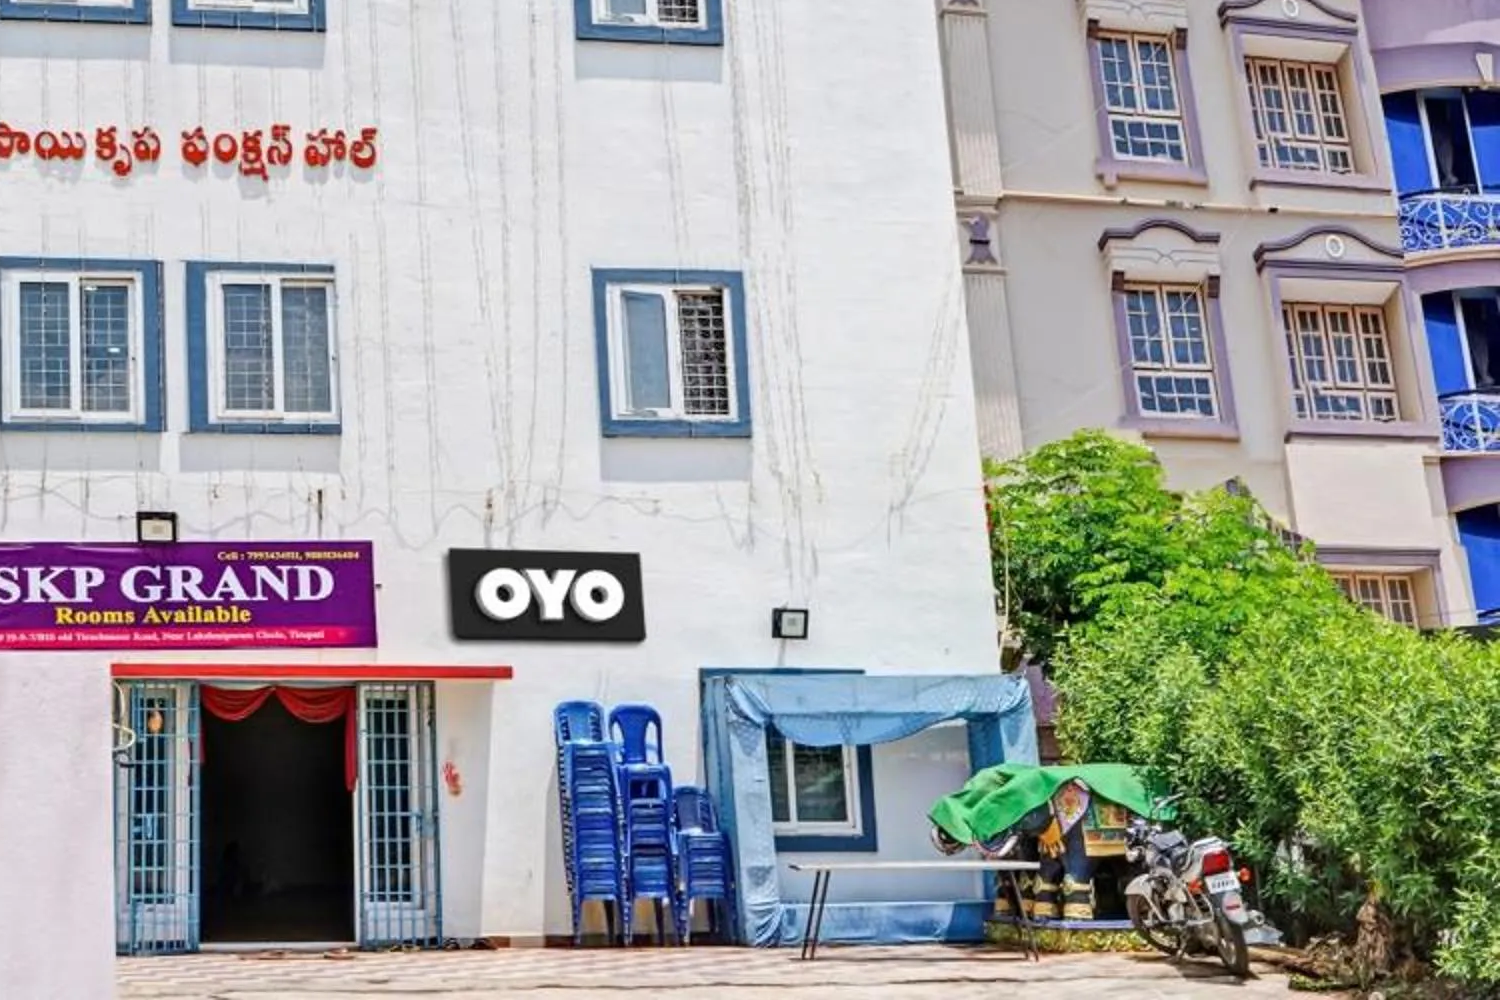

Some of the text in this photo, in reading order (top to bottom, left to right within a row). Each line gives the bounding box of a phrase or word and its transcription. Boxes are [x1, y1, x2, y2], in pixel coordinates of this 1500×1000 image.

[304, 127, 378, 169] హాల్
[120, 564, 335, 602] GRAND
[474, 567, 625, 622] OYO
[55, 604, 253, 625] Rooms Available
